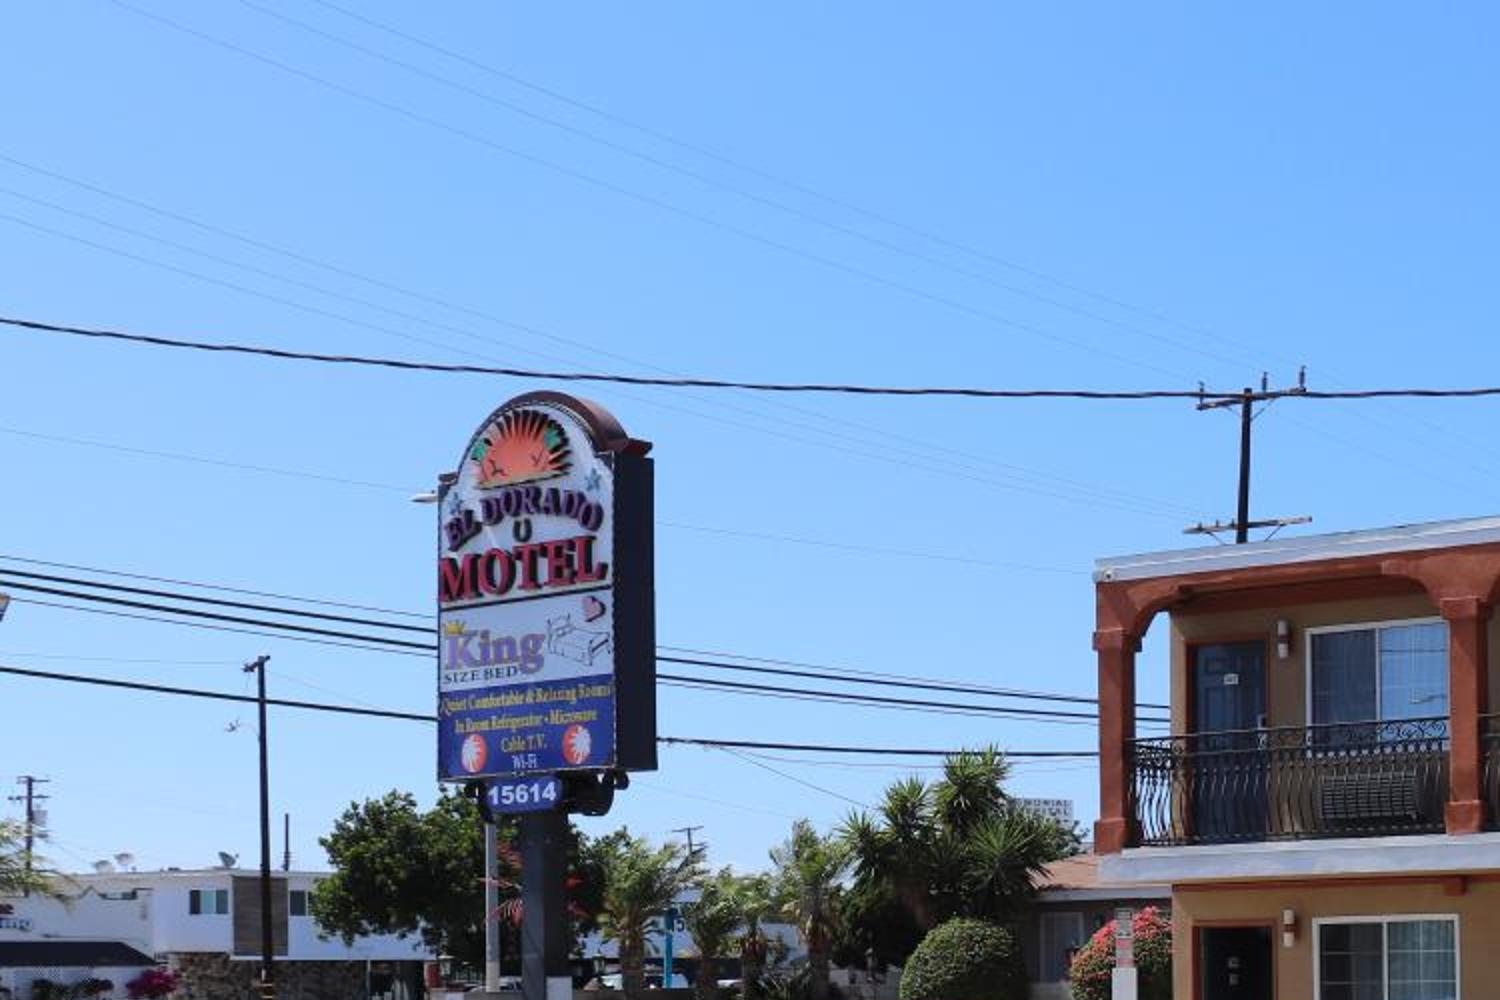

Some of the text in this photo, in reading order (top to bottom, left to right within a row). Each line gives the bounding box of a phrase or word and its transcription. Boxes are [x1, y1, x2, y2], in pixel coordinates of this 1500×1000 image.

[446, 486, 604, 551] EL DORADO
[440, 535, 608, 602] MOTEL
[445, 629, 545, 674] King
[444, 665, 518, 684] SIZE BED
[501, 735, 526, 752] Cable
[487, 781, 557, 806] 15614
